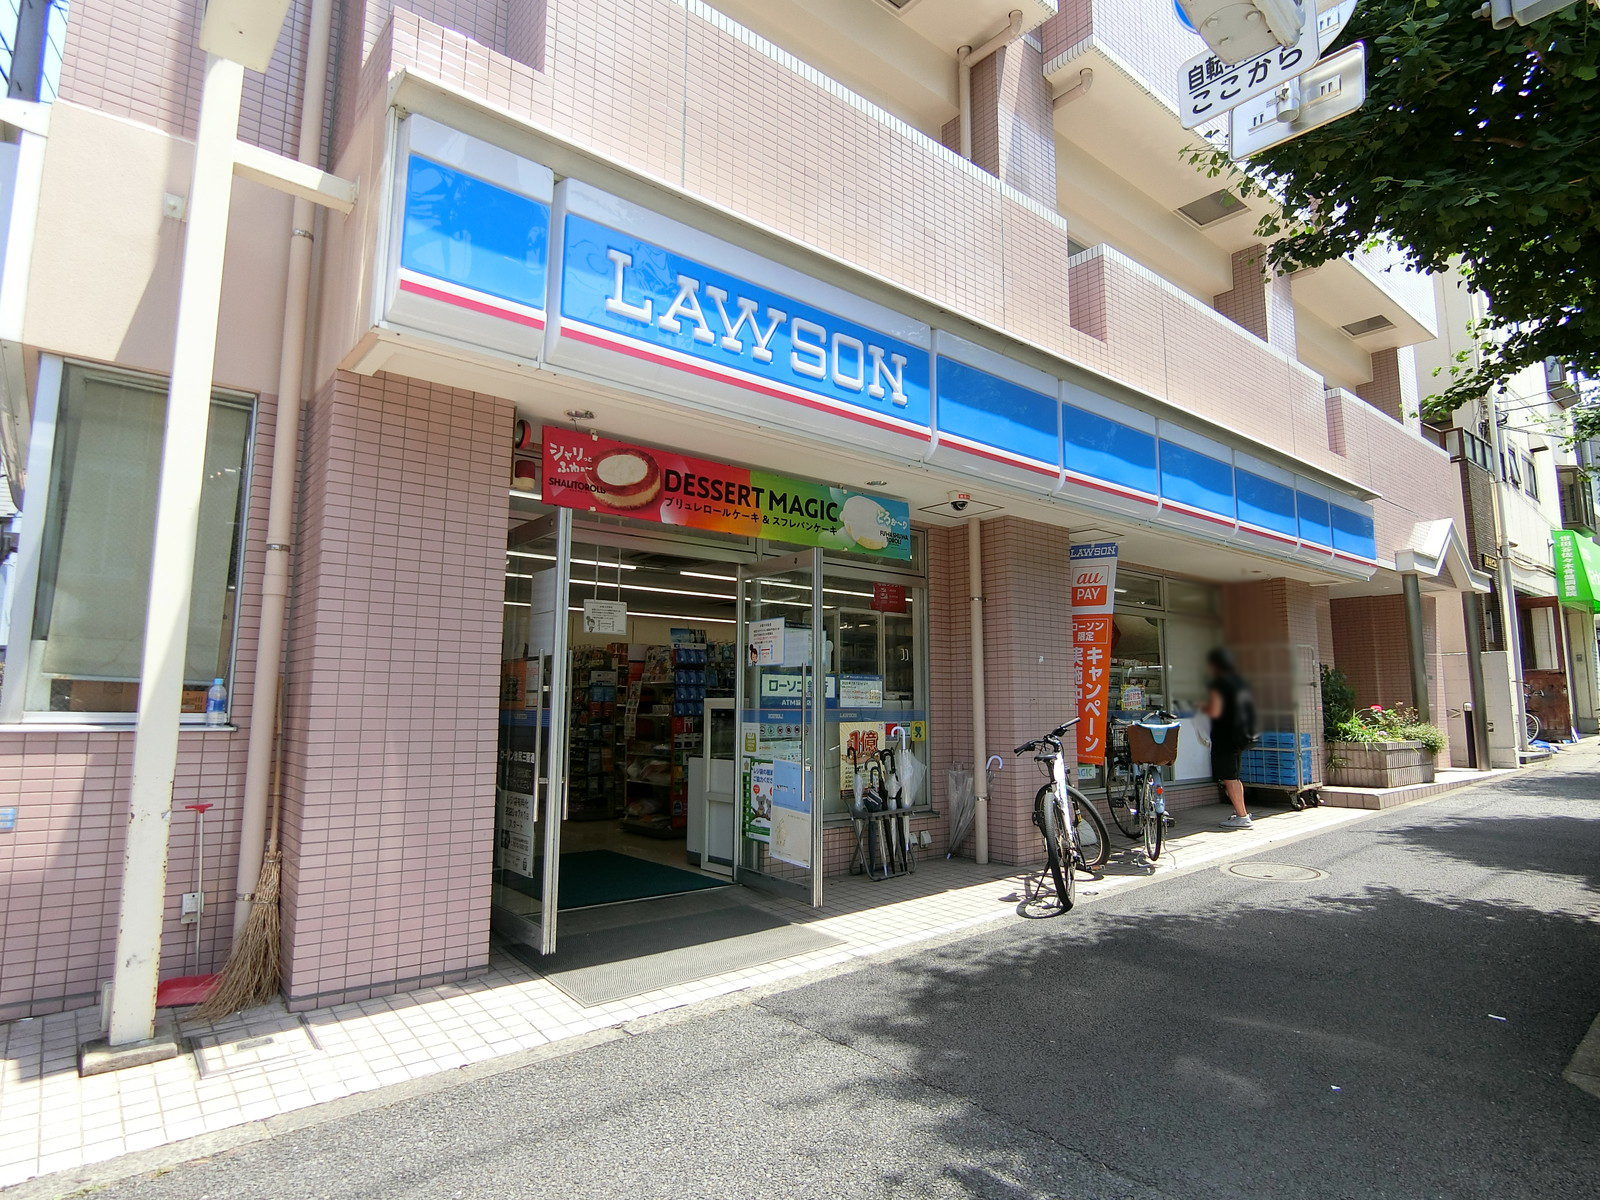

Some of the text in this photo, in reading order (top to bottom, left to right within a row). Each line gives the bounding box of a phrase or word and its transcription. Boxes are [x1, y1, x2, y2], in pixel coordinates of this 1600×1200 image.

[1188, 54, 1236, 91] 自転
[1192, 48, 1303, 114] ここから
[605, 248, 908, 407] LAWSON
[549, 442, 593, 462] シャリっと
[664, 468, 838, 522] DESSERT MAGIC
[665, 496, 760, 523] ブリュレロールケーキ
[762, 514, 770, 525] &
[1070, 545, 1116, 558] LAWSON
[1076, 572, 1104, 585] au
[1076, 587, 1101, 601] PAY
[1072, 622, 1105, 632] ローソン
[1077, 631, 1095, 642] 限定
[1086, 646, 1104, 753] キャンペーン
